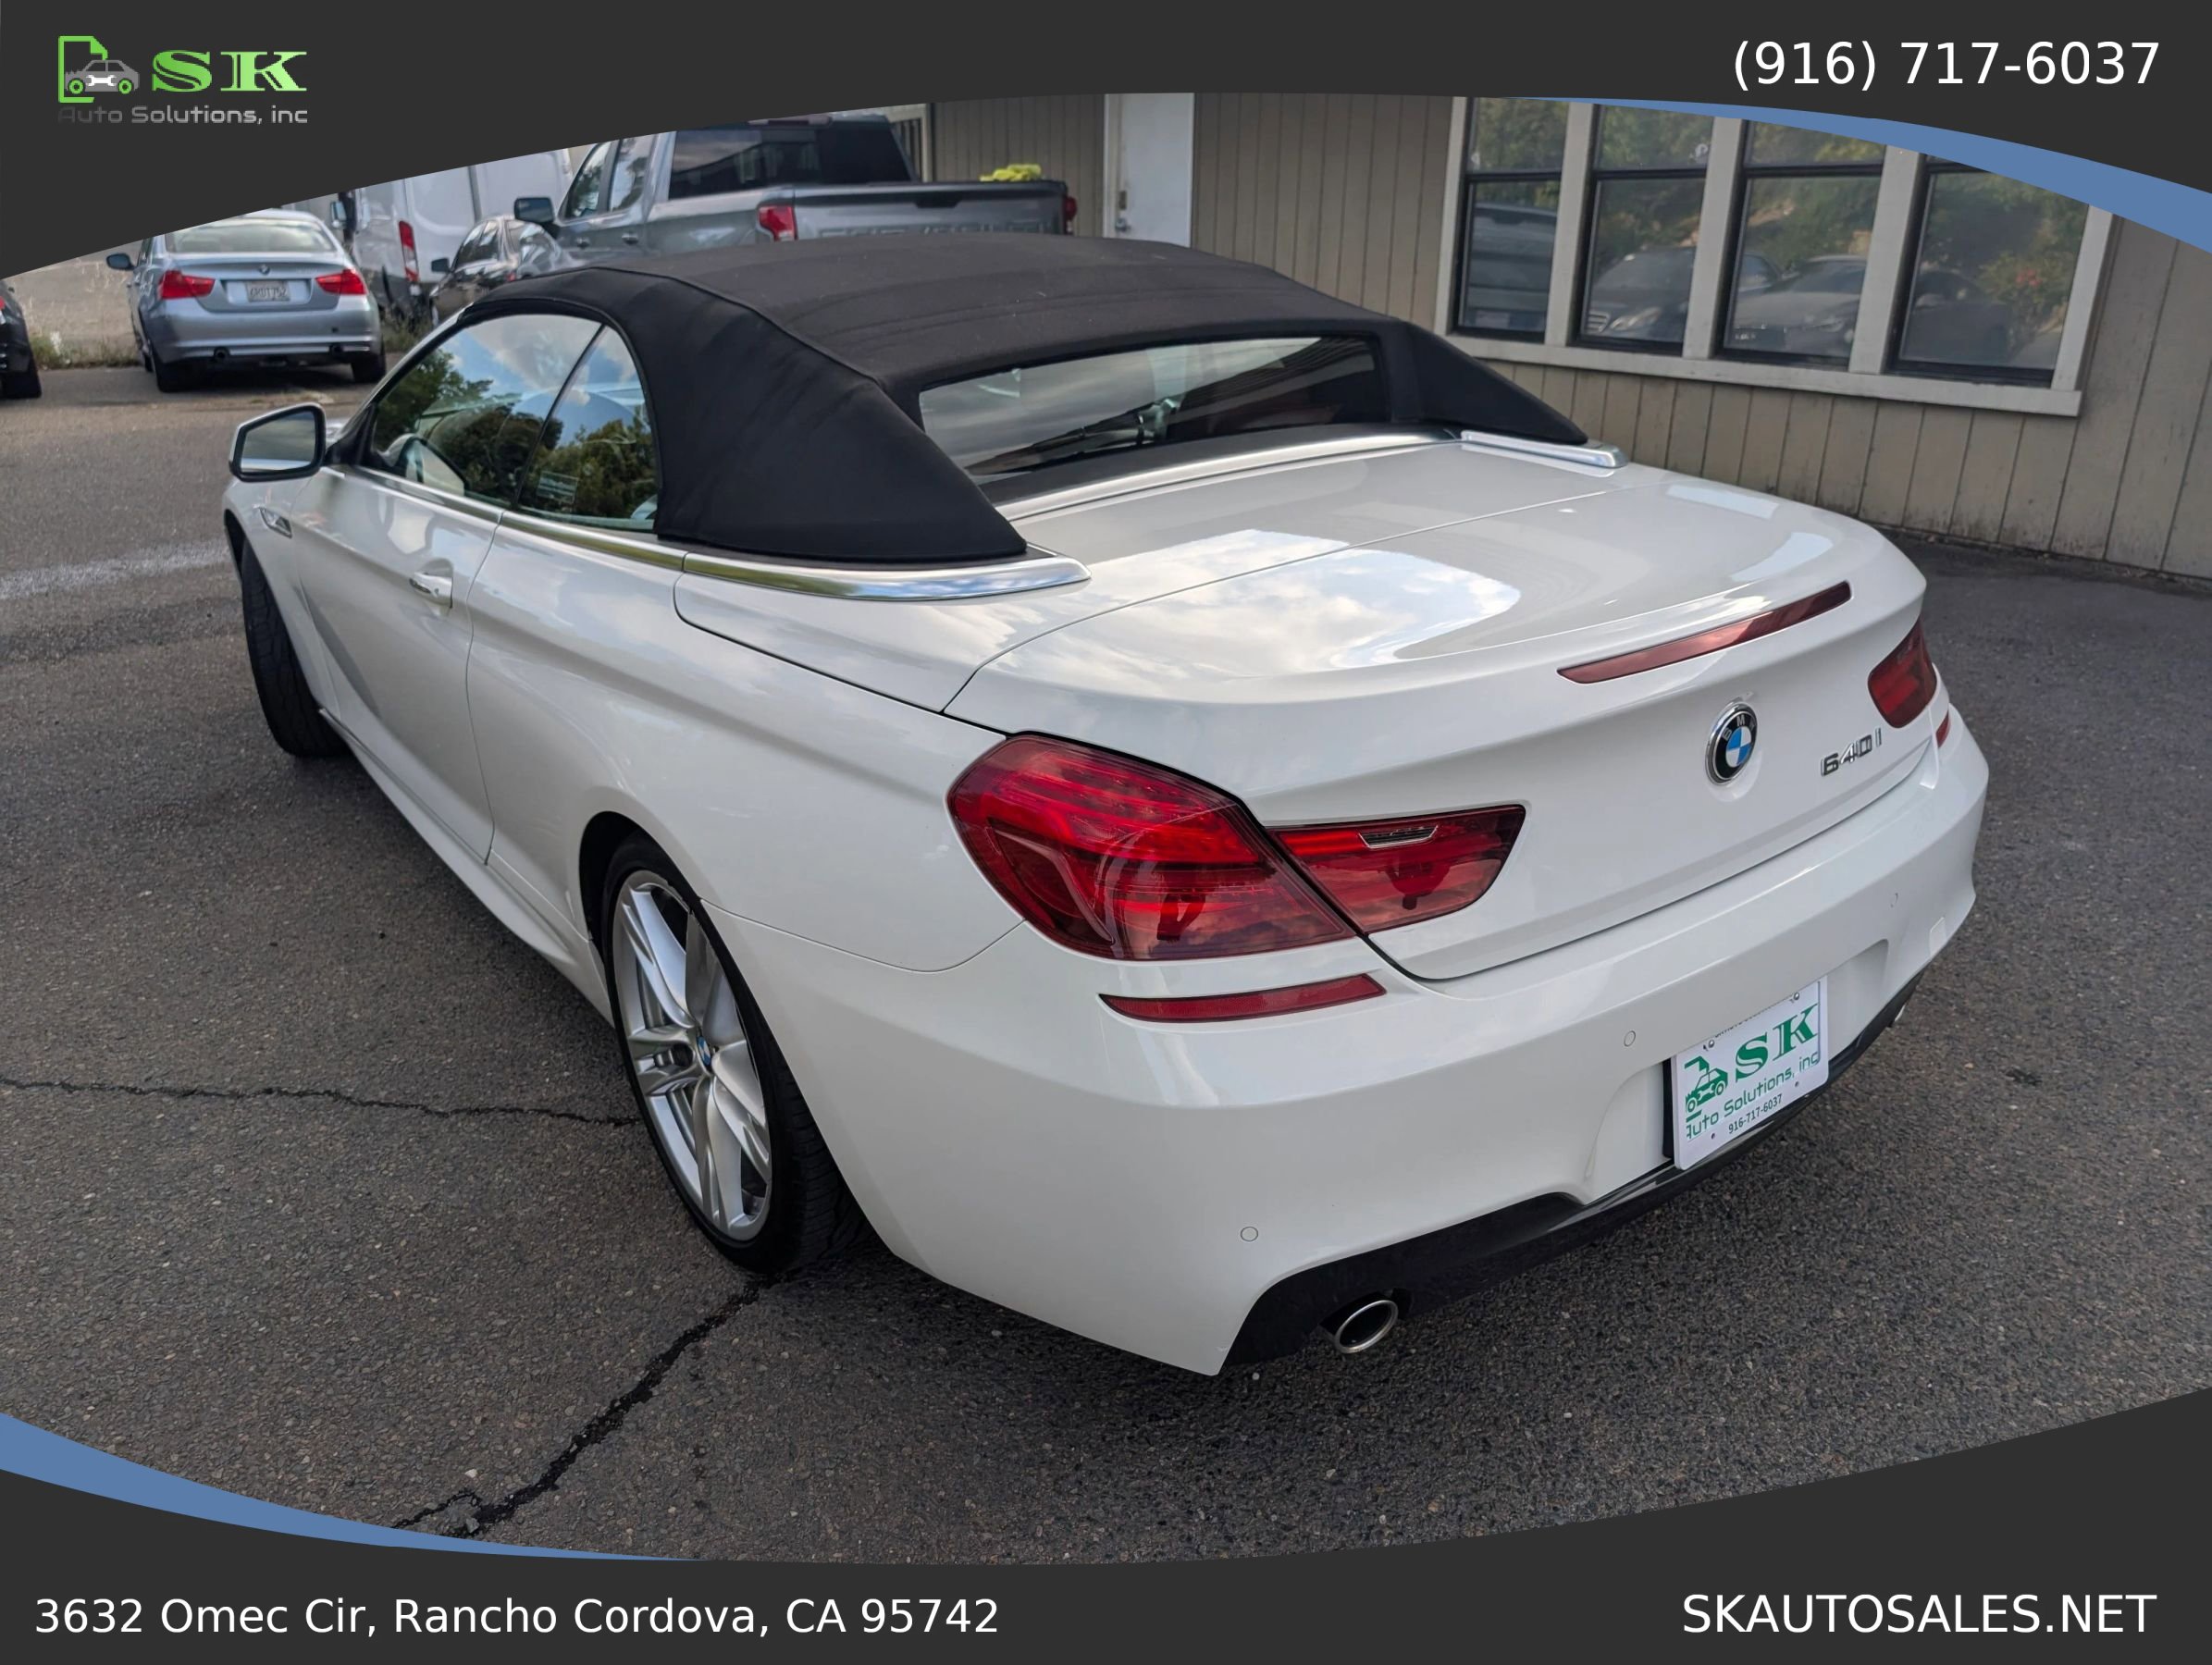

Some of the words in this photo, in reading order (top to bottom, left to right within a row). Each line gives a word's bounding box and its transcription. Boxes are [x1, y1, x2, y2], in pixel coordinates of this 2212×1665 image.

[1735, 1002, 1819, 1083] SK
[1724, 1067, 1796, 1117] Solutions,
[1728, 1093, 1783, 1134] 916-717-6037
